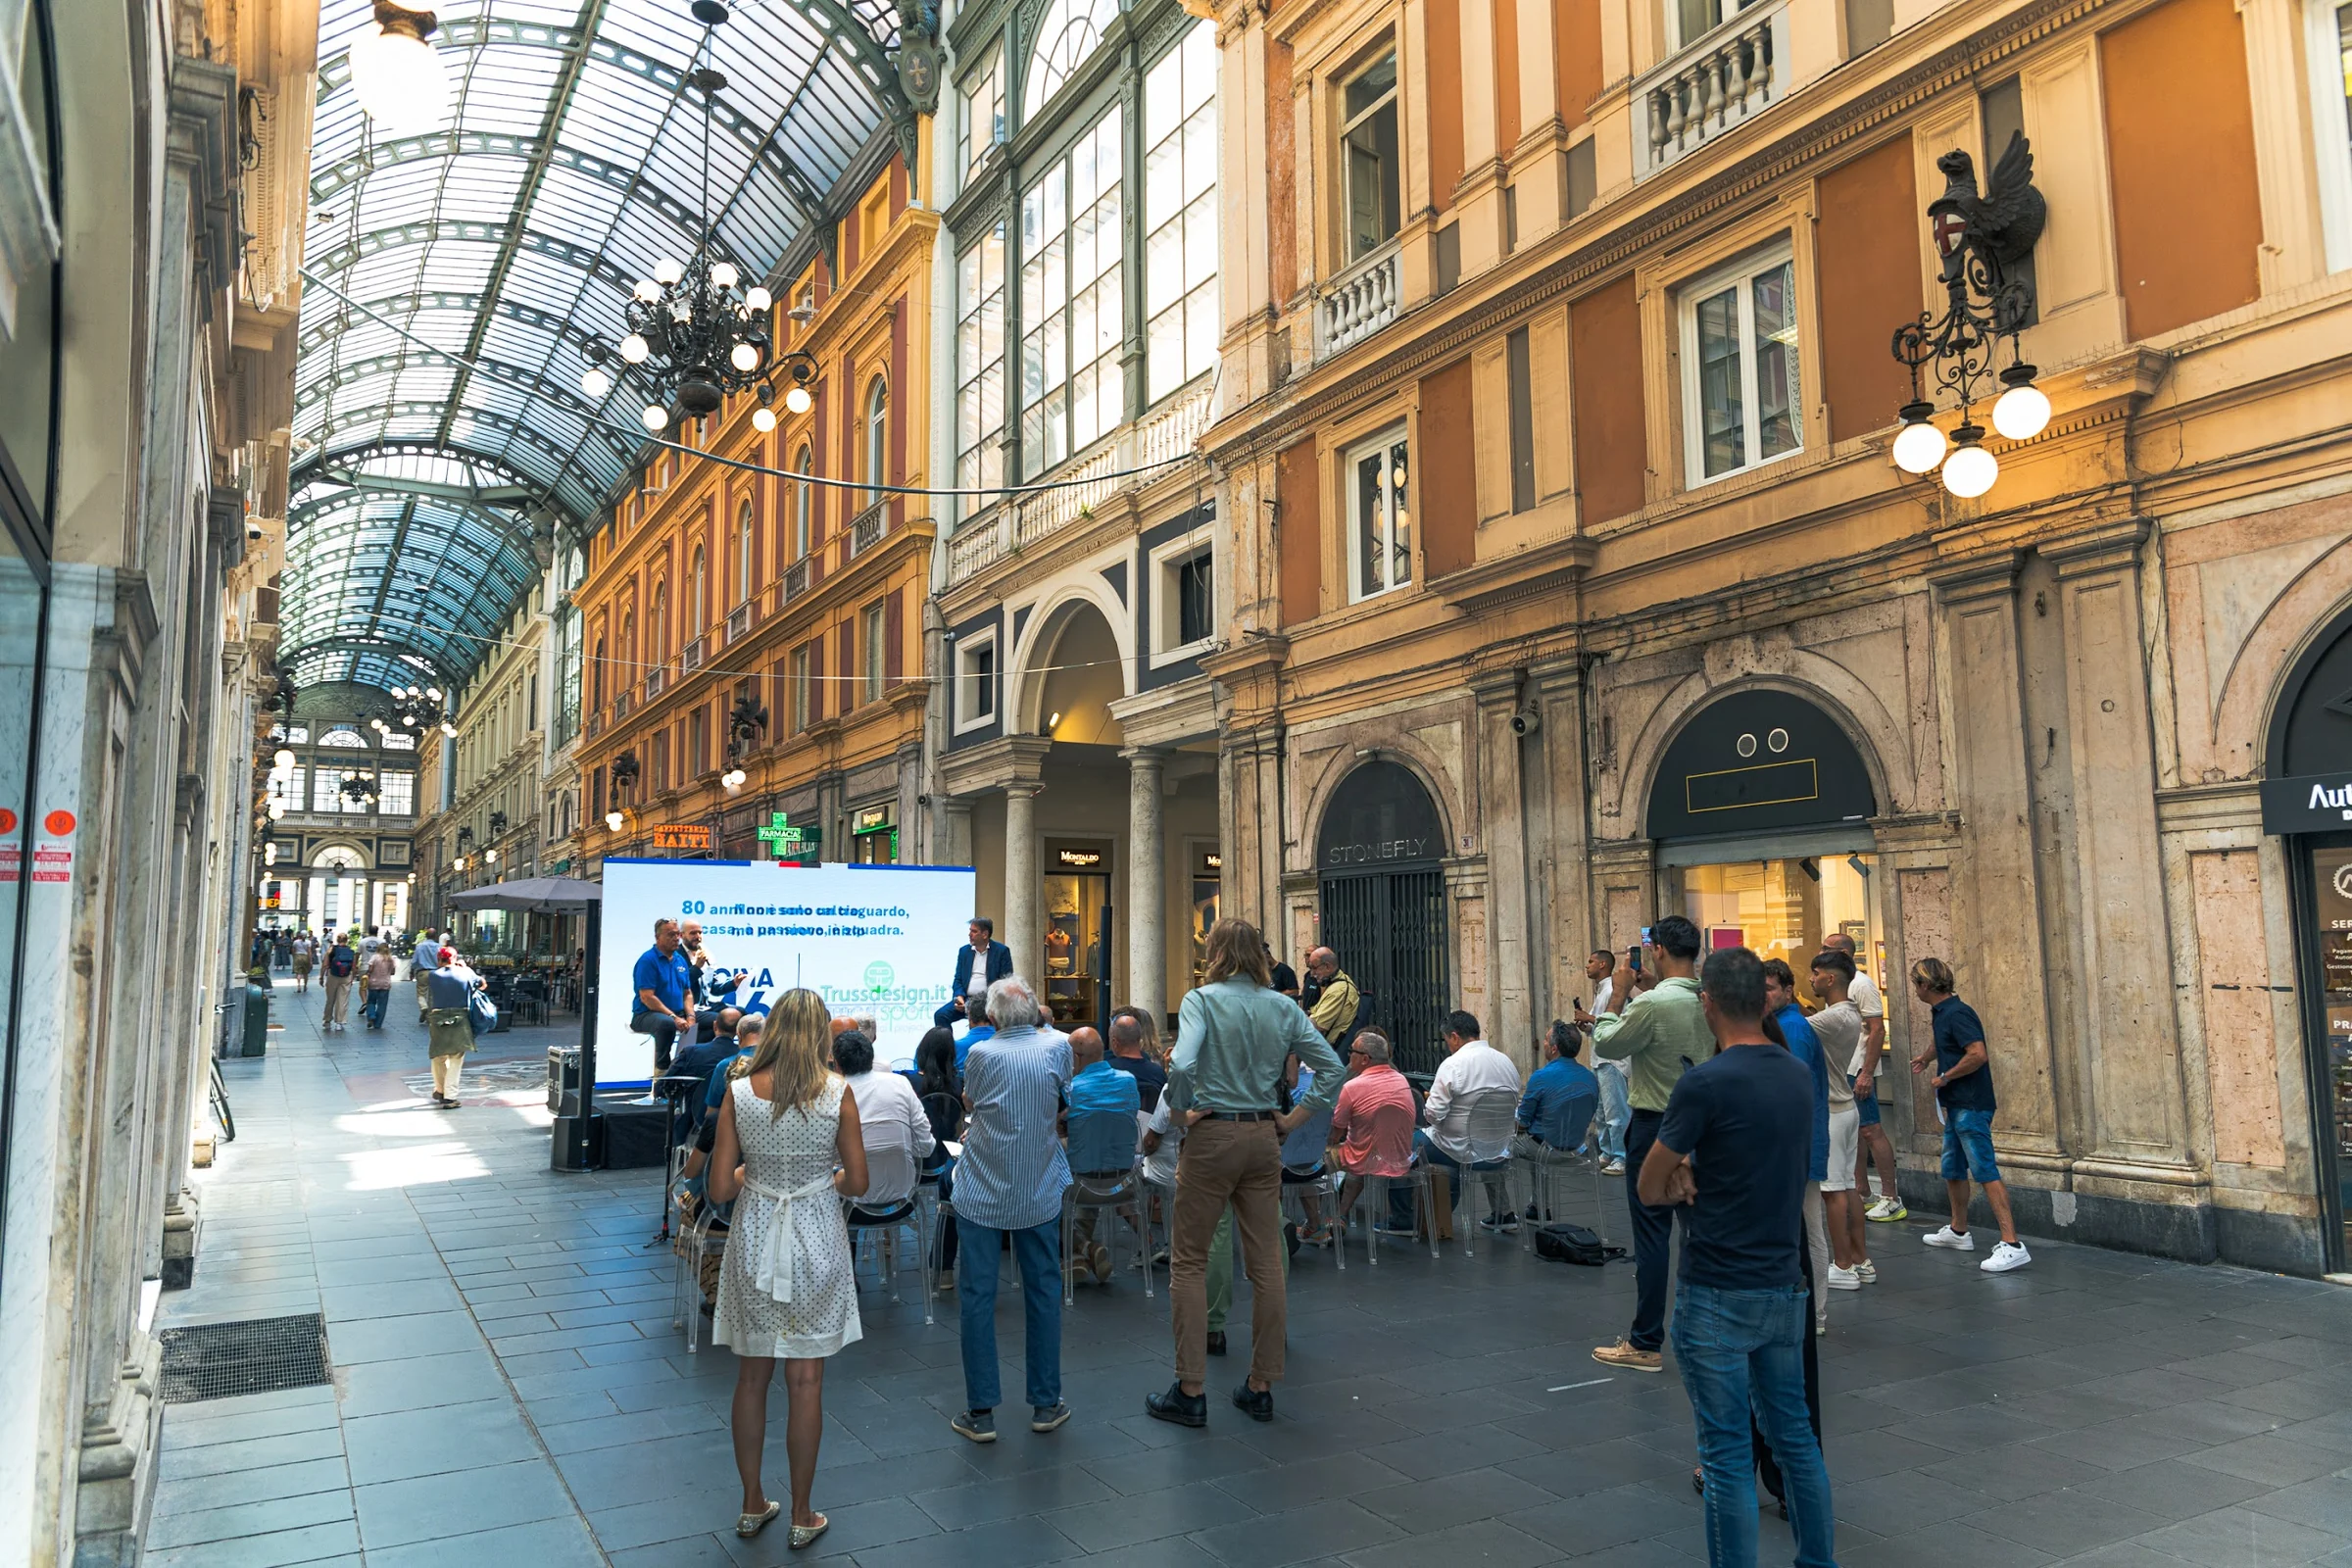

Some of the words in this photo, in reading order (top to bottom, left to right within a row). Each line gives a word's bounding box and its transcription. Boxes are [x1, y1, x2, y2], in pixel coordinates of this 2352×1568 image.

[653, 833, 710, 849] HAITI
[1060, 851, 1100, 861] MONTALDO
[1330, 838, 1427, 863] STONEFLY
[682, 900, 706, 915] 80
